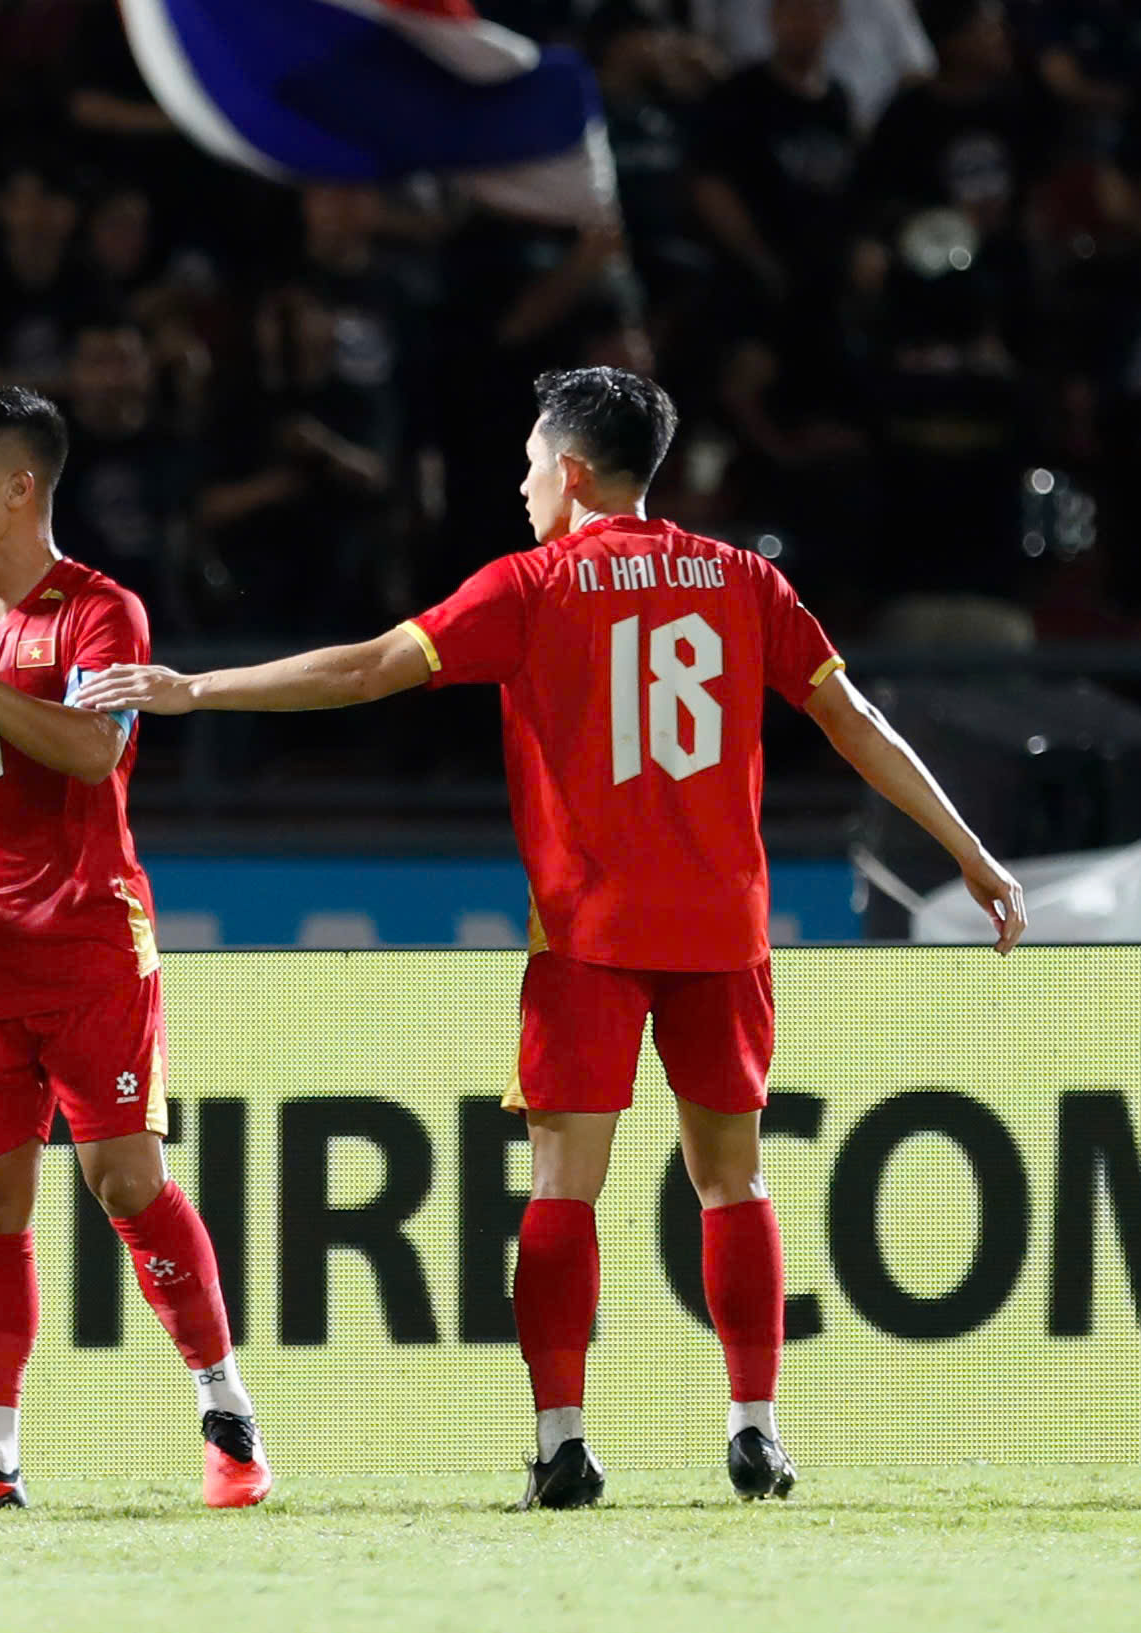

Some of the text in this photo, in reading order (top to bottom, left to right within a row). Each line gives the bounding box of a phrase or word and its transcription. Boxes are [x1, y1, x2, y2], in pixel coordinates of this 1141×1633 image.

[611, 553, 657, 591] HAI
[662, 553, 725, 589] LONG
[611, 612, 723, 786] 18
